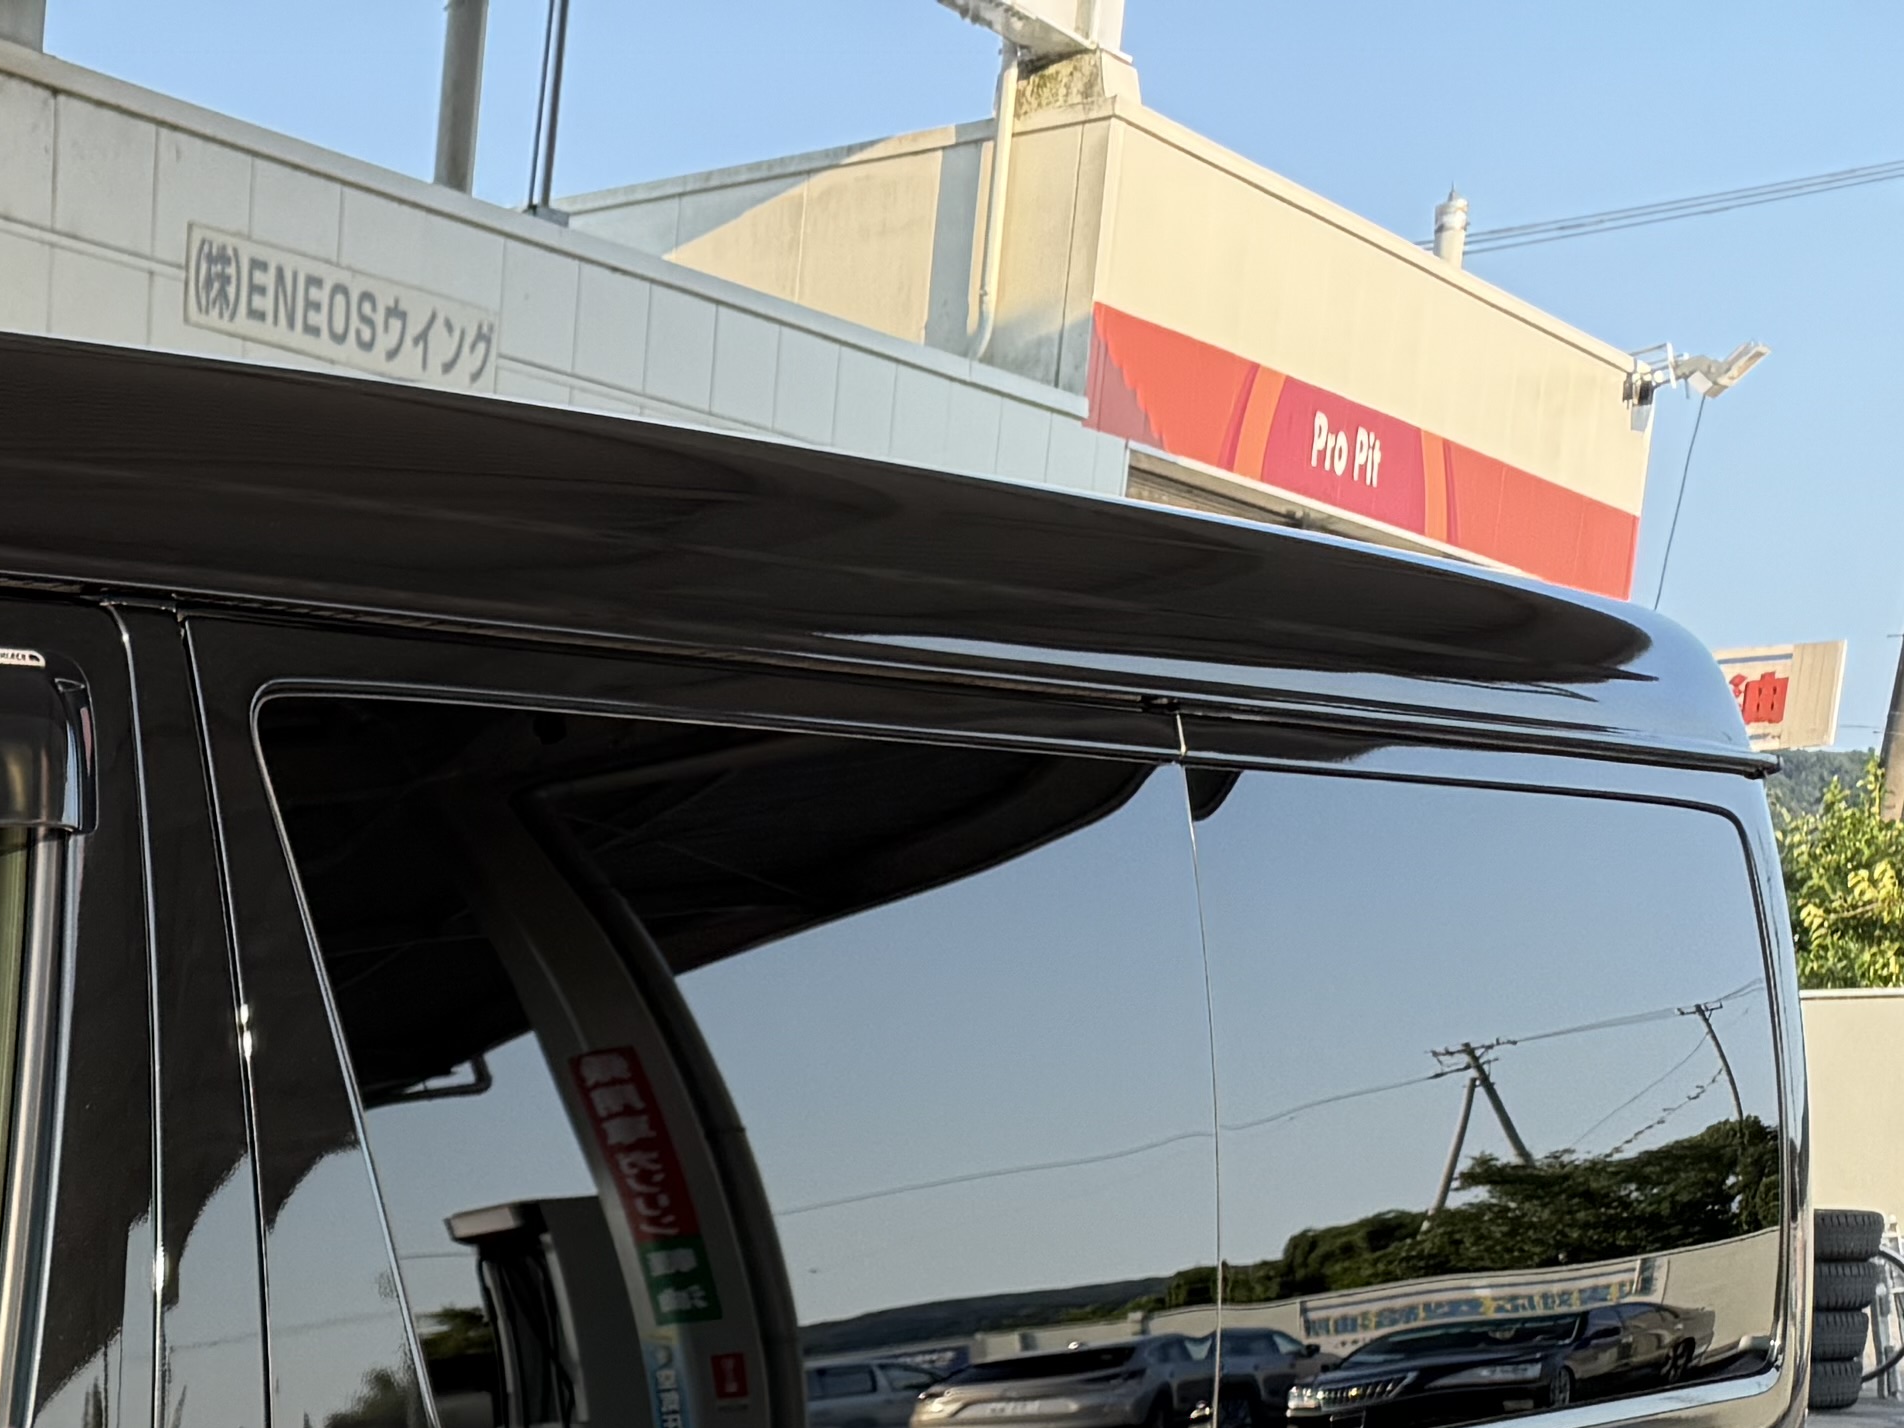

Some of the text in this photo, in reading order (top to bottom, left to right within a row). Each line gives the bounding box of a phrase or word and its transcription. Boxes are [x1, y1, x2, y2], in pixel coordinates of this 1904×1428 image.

[193, 236, 494, 385] (株)ENEOSウイング
[1311, 410, 1382, 488] Pro Pit
